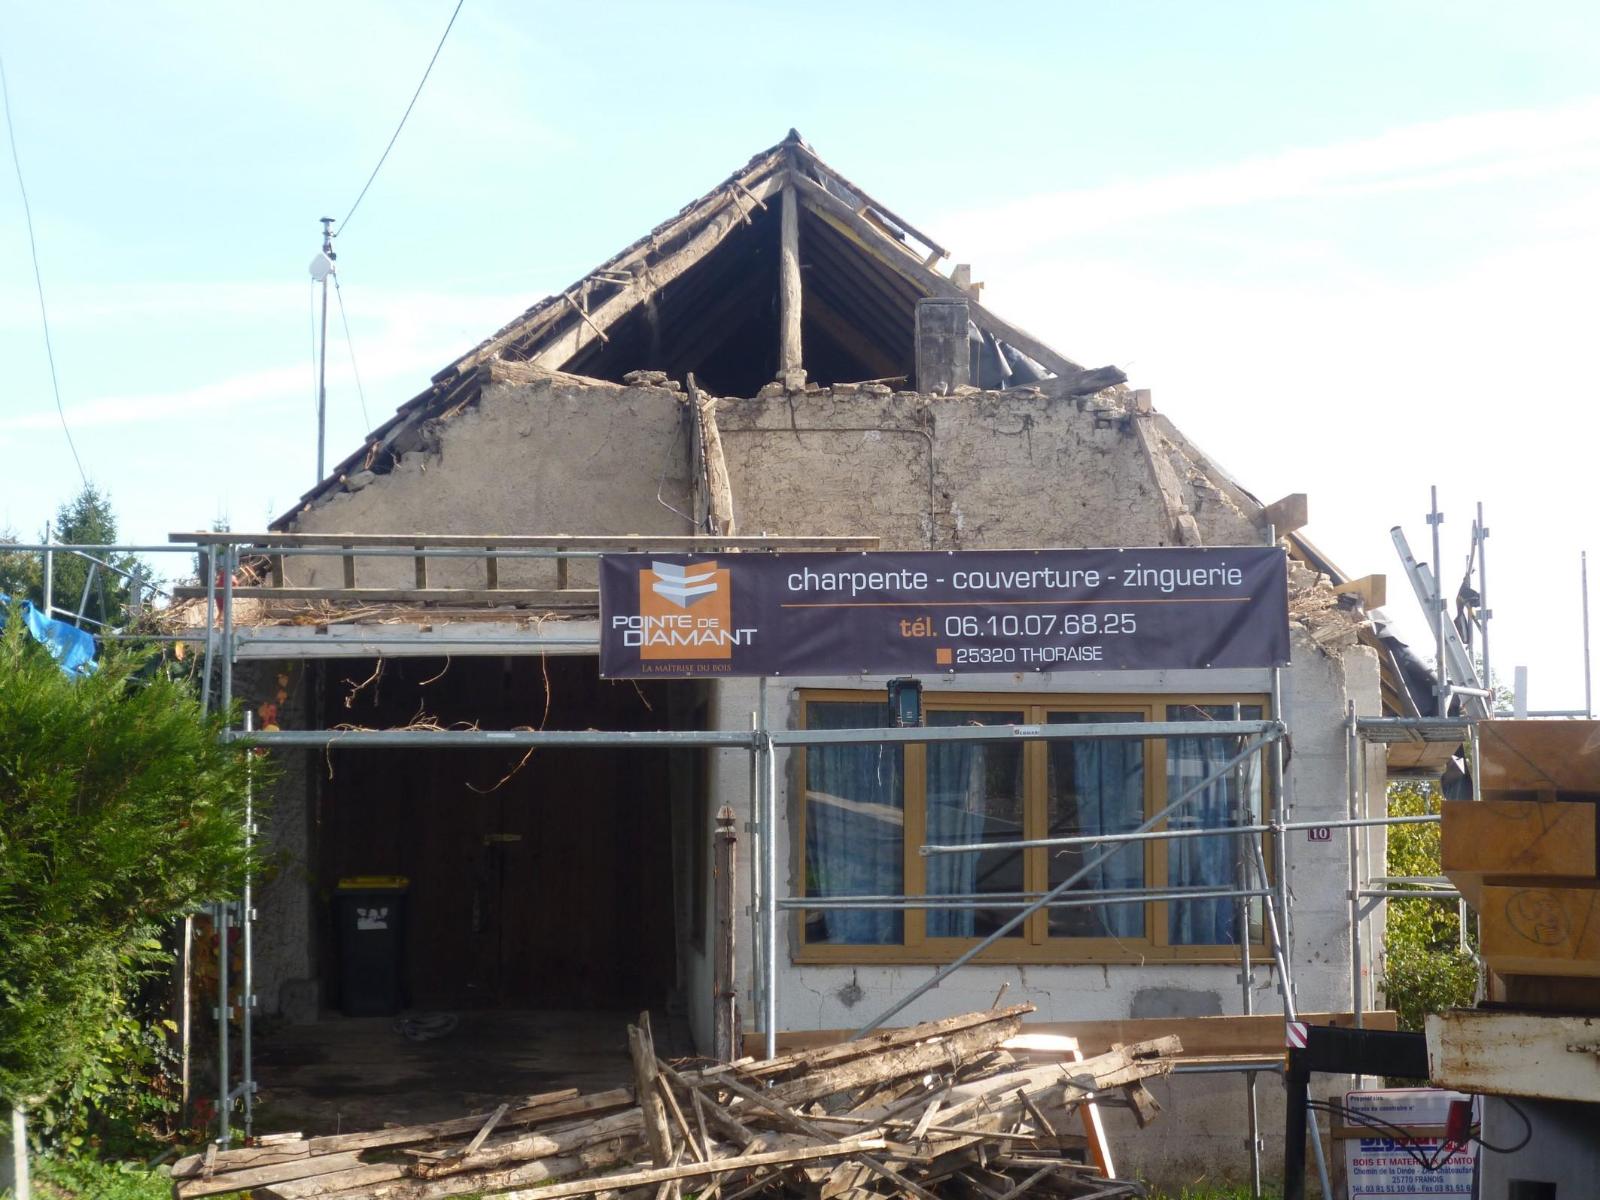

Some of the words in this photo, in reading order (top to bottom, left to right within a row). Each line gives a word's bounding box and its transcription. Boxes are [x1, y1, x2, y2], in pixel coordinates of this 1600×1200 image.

[787, 566, 928, 597] charpente
[952, 566, 1100, 590] couverture
[1123, 562, 1243, 593] zinguerie
[612, 614, 692, 629] POINTE
[697, 617, 720, 628] DE
[900, 616, 938, 638] tél.
[944, 613, 1137, 637] 06.10.07.68.25
[623, 628, 758, 647] DIAMANT
[956, 647, 1016, 664] 25320
[1020, 646, 1104, 663] THORAISE
[642, 664, 652, 673] LA
[697, 663, 711, 672] DU
[712, 663, 732, 672] BOIS
[1312, 827, 1328, 839] 10
[1352, 1158, 1374, 1167] BOIS
[1376, 1158, 1387, 1167] ET
[1353, 1167, 1378, 1175] Chemin
[1391, 1175, 1414, 1184] 25770
